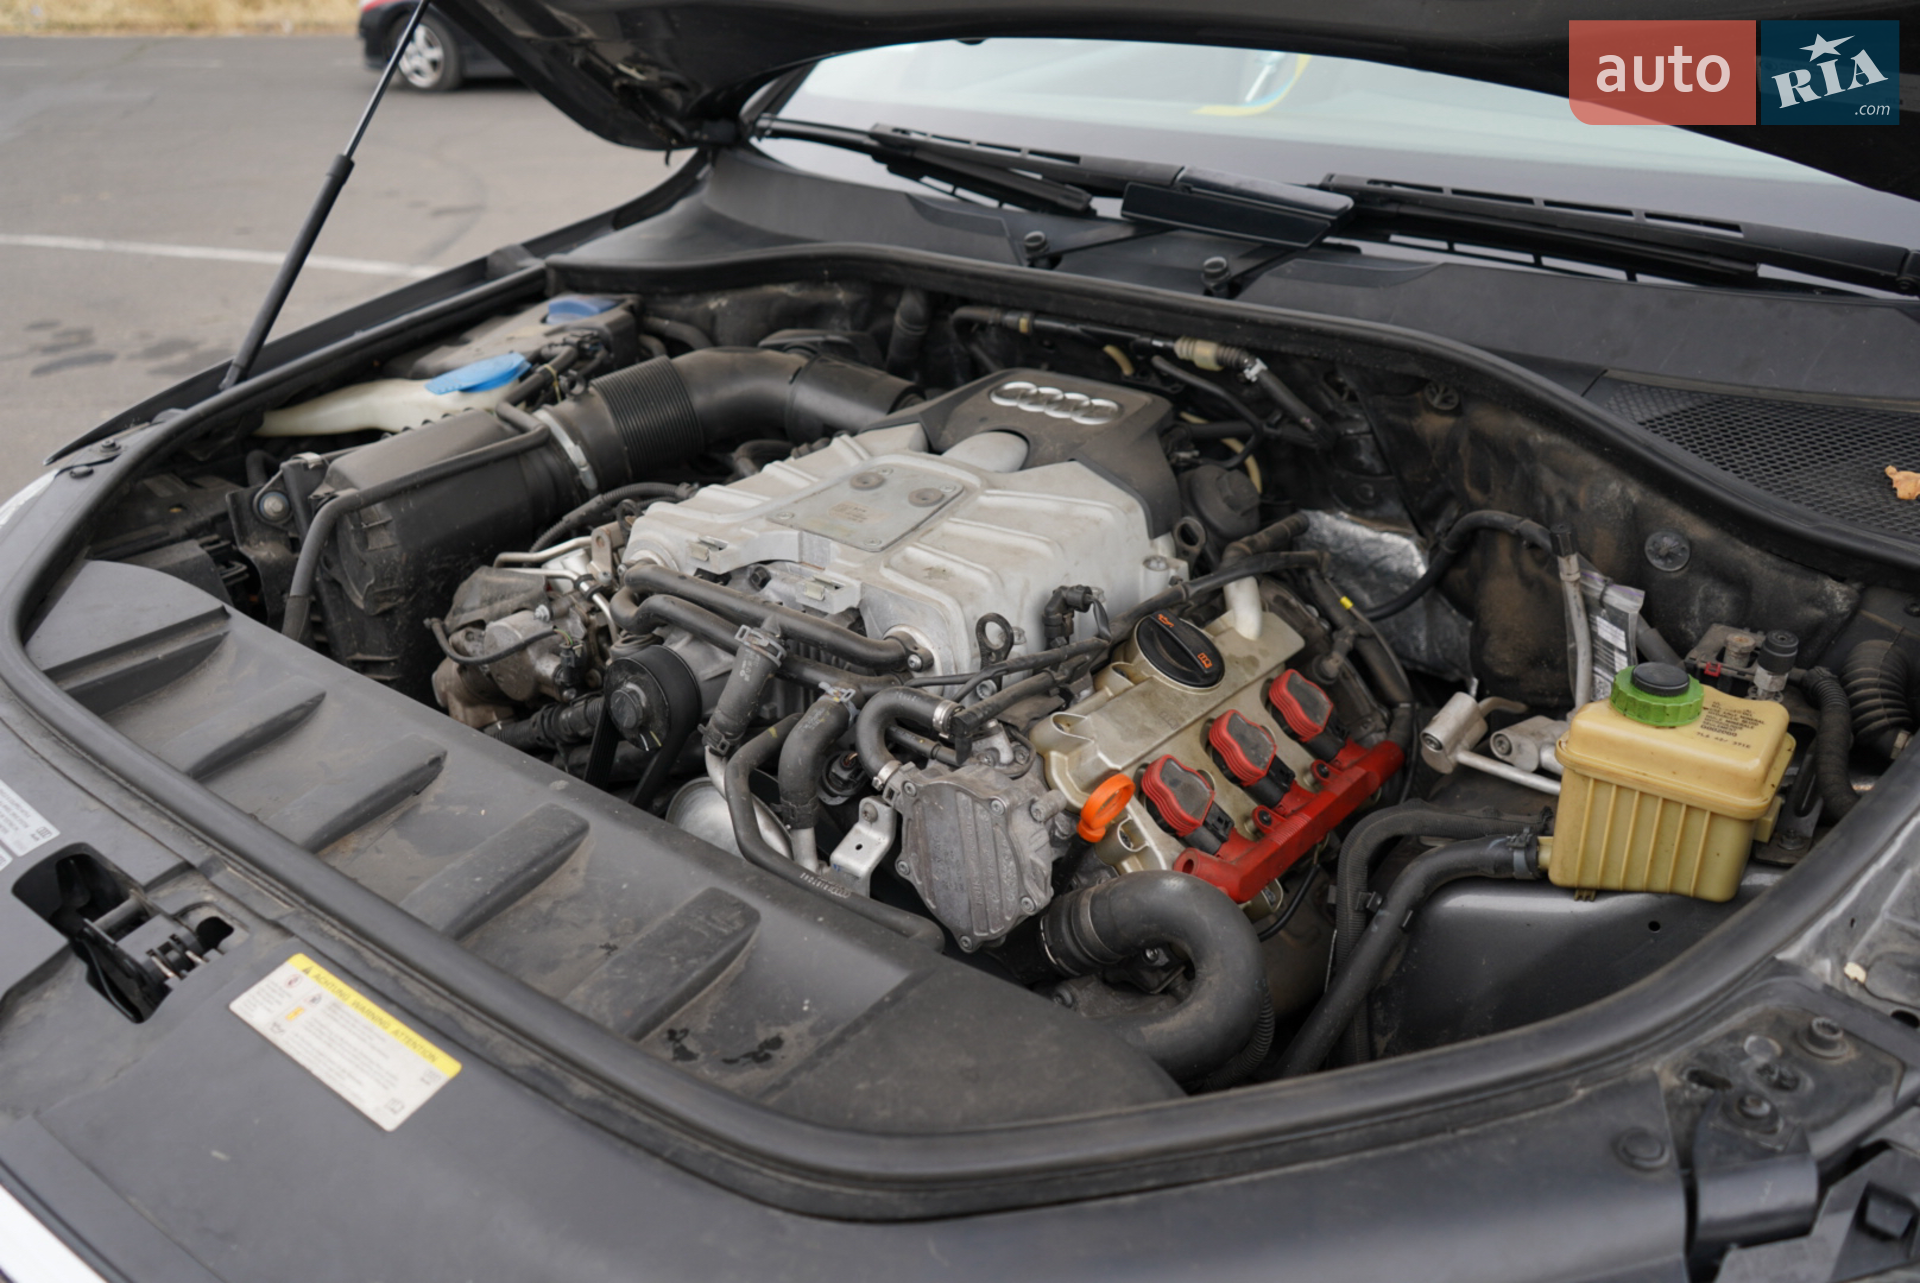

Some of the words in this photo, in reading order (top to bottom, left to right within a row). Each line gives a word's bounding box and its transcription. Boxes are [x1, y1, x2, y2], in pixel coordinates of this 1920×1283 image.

[312, 973, 350, 1001] ACHTUNG
[352, 1000, 391, 1029] WARNING
[392, 1028, 438, 1062] ATTENTION
